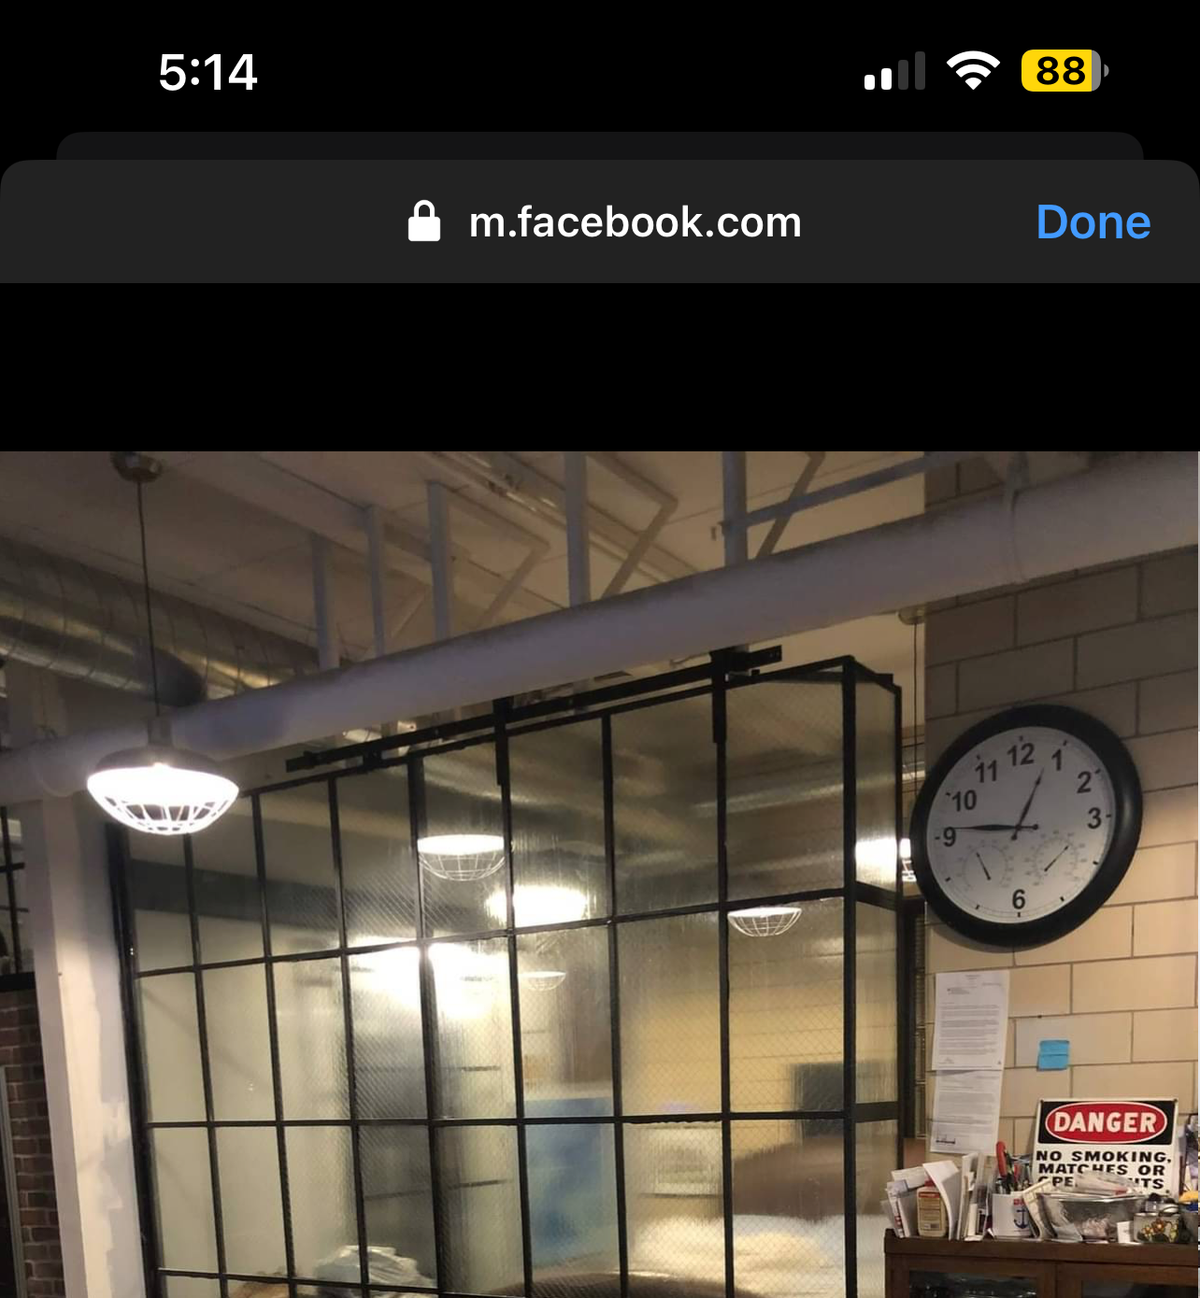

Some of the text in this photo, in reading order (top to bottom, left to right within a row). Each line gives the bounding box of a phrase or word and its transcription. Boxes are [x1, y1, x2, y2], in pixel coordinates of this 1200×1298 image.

[160, 54, 257, 91] 5:14
[1037, 57, 1085, 85] 88
[471, 205, 800, 237] m.facebook.com
[1039, 205, 1150, 239] Done
[1007, 743, 1035, 767] 12
[1051, 749, 1063, 771] 1
[974, 760, 998, 783] 11
[1076, 771, 1092, 794] 2
[951, 789, 977, 812] 10
[1087, 807, 1102, 830] 3
[942, 827, 957, 847] 9
[1012, 889, 1026, 910] 6
[1054, 1111, 1157, 1133] DANGER
[1036, 1150, 1172, 1163] NO SMOKING,
[1138, 1165, 1166, 1176] OR
